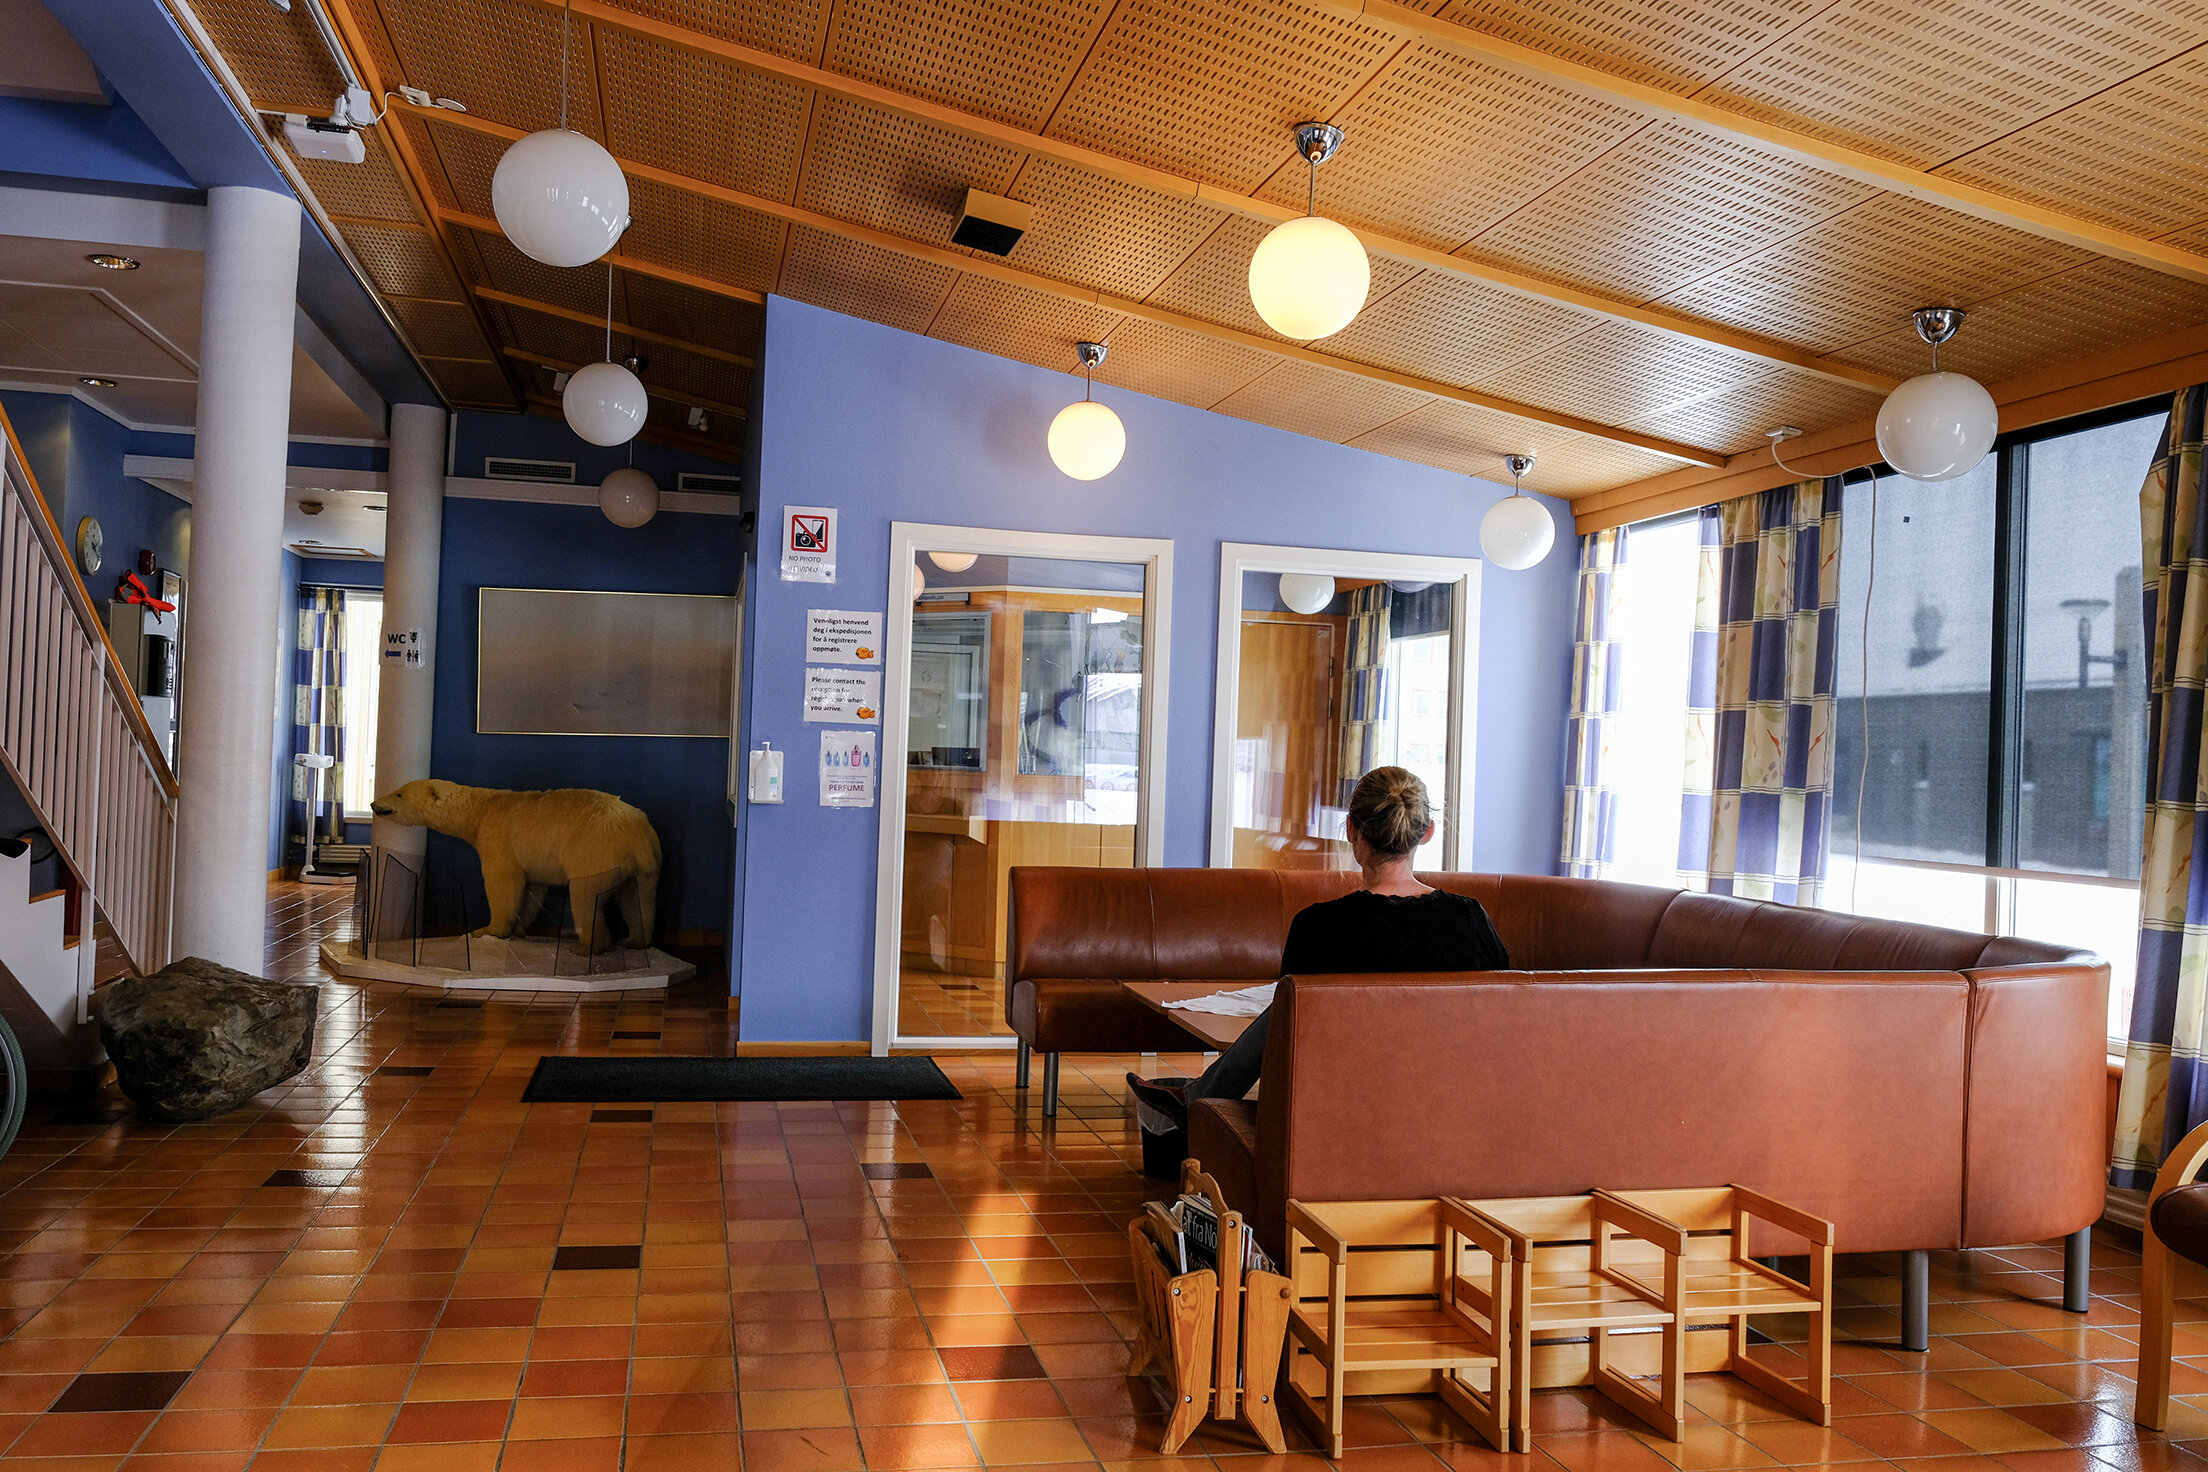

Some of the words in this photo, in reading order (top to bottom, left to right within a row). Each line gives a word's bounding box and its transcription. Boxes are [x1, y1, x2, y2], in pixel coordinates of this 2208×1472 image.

[800, 555, 821, 563] PHOTO
[800, 565, 819, 573] VIDEO
[842, 618, 869, 626] henvend
[812, 626, 824, 634] deg
[829, 627, 872, 636] ekspedisjonen
[387, 633, 406, 644] WC
[811, 676, 831, 684] Please
[828, 783, 865, 792] PERFUME
[1192, 1215, 1204, 1242] fra
